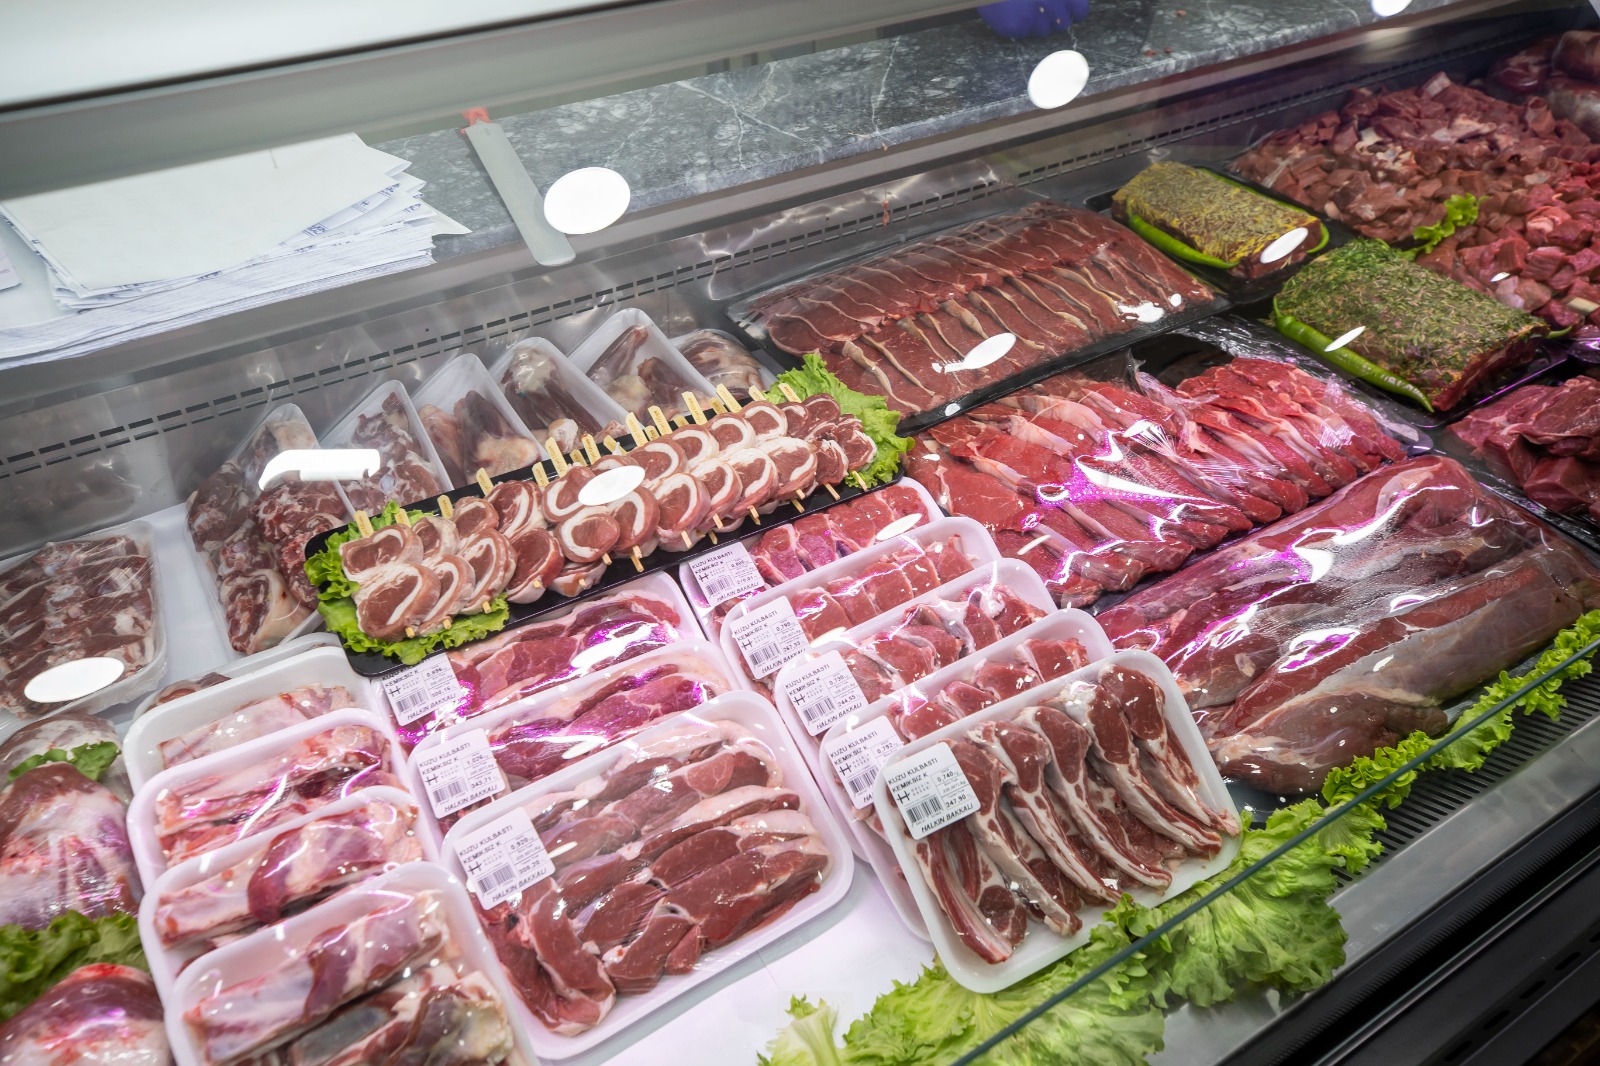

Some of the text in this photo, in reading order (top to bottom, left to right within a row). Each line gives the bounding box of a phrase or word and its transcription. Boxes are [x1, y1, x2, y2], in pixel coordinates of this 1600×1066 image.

[408, 694, 456, 719] HALKIN BAKKALI
[817, 703, 862, 729] HALKIN BAKKALI
[420, 743, 471, 767] KUZU KULBASTI
[830, 732, 878, 758] KUZU KULBASTI
[888, 758, 938, 785] KUZU KULBASTI
[892, 776, 922, 792] KEMIKSIZ
[445, 786, 497, 812] HALKIN BAKKALI
[946, 795, 967, 807] 247,90
[922, 817, 946, 832] HALKIN
[946, 804, 974, 820] BAKKALI
[460, 826, 513, 856] KUZU KULBASTI
[493, 869, 547, 902] HALKIN BAKKALI
